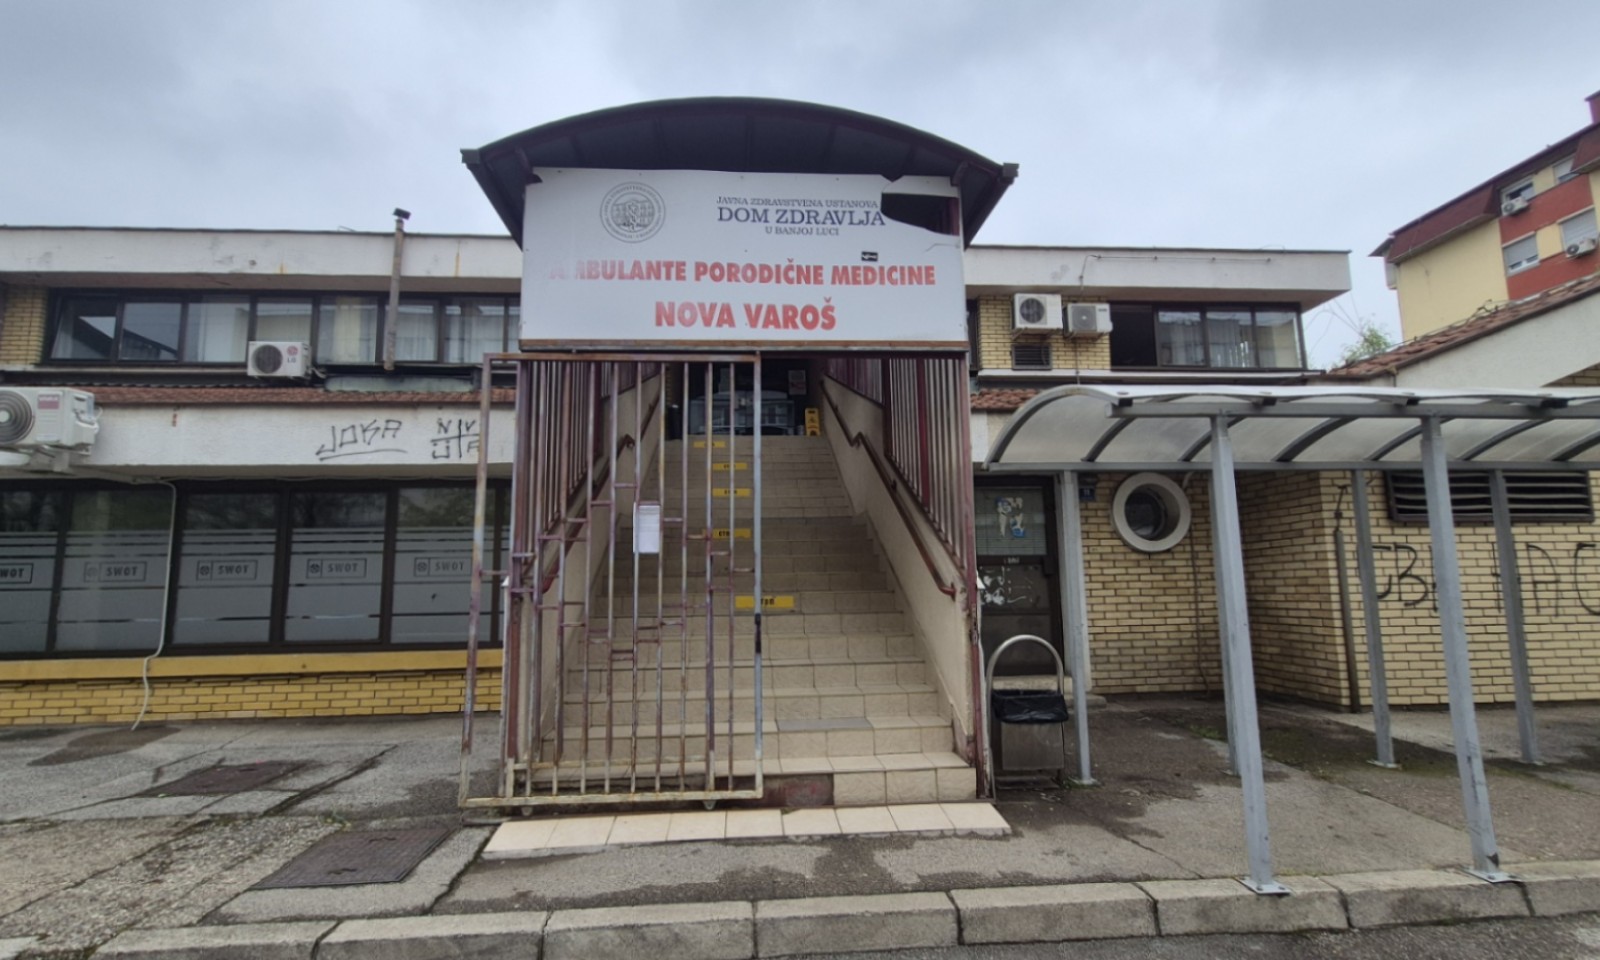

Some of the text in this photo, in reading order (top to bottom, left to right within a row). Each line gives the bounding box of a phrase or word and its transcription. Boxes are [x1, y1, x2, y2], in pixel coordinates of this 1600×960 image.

[716, 196, 879, 208] JAVNA ZDRAVSTVENA USTANOVA
[717, 206, 886, 226] DOM ZDRAVLJA
[765, 226, 840, 236] U BANJOJ LUCI
[694, 258, 824, 286] PORODIČNE
[831, 265, 936, 286] MEDICINE
[655, 297, 836, 331] NOVA VAROŠ
[106, 566, 138, 576] SWOT
[218, 564, 249, 575] SWOT
[327, 562, 359, 573] SWOT
[434, 561, 465, 571] SWOT
[0, 567, 24, 578] WOT
